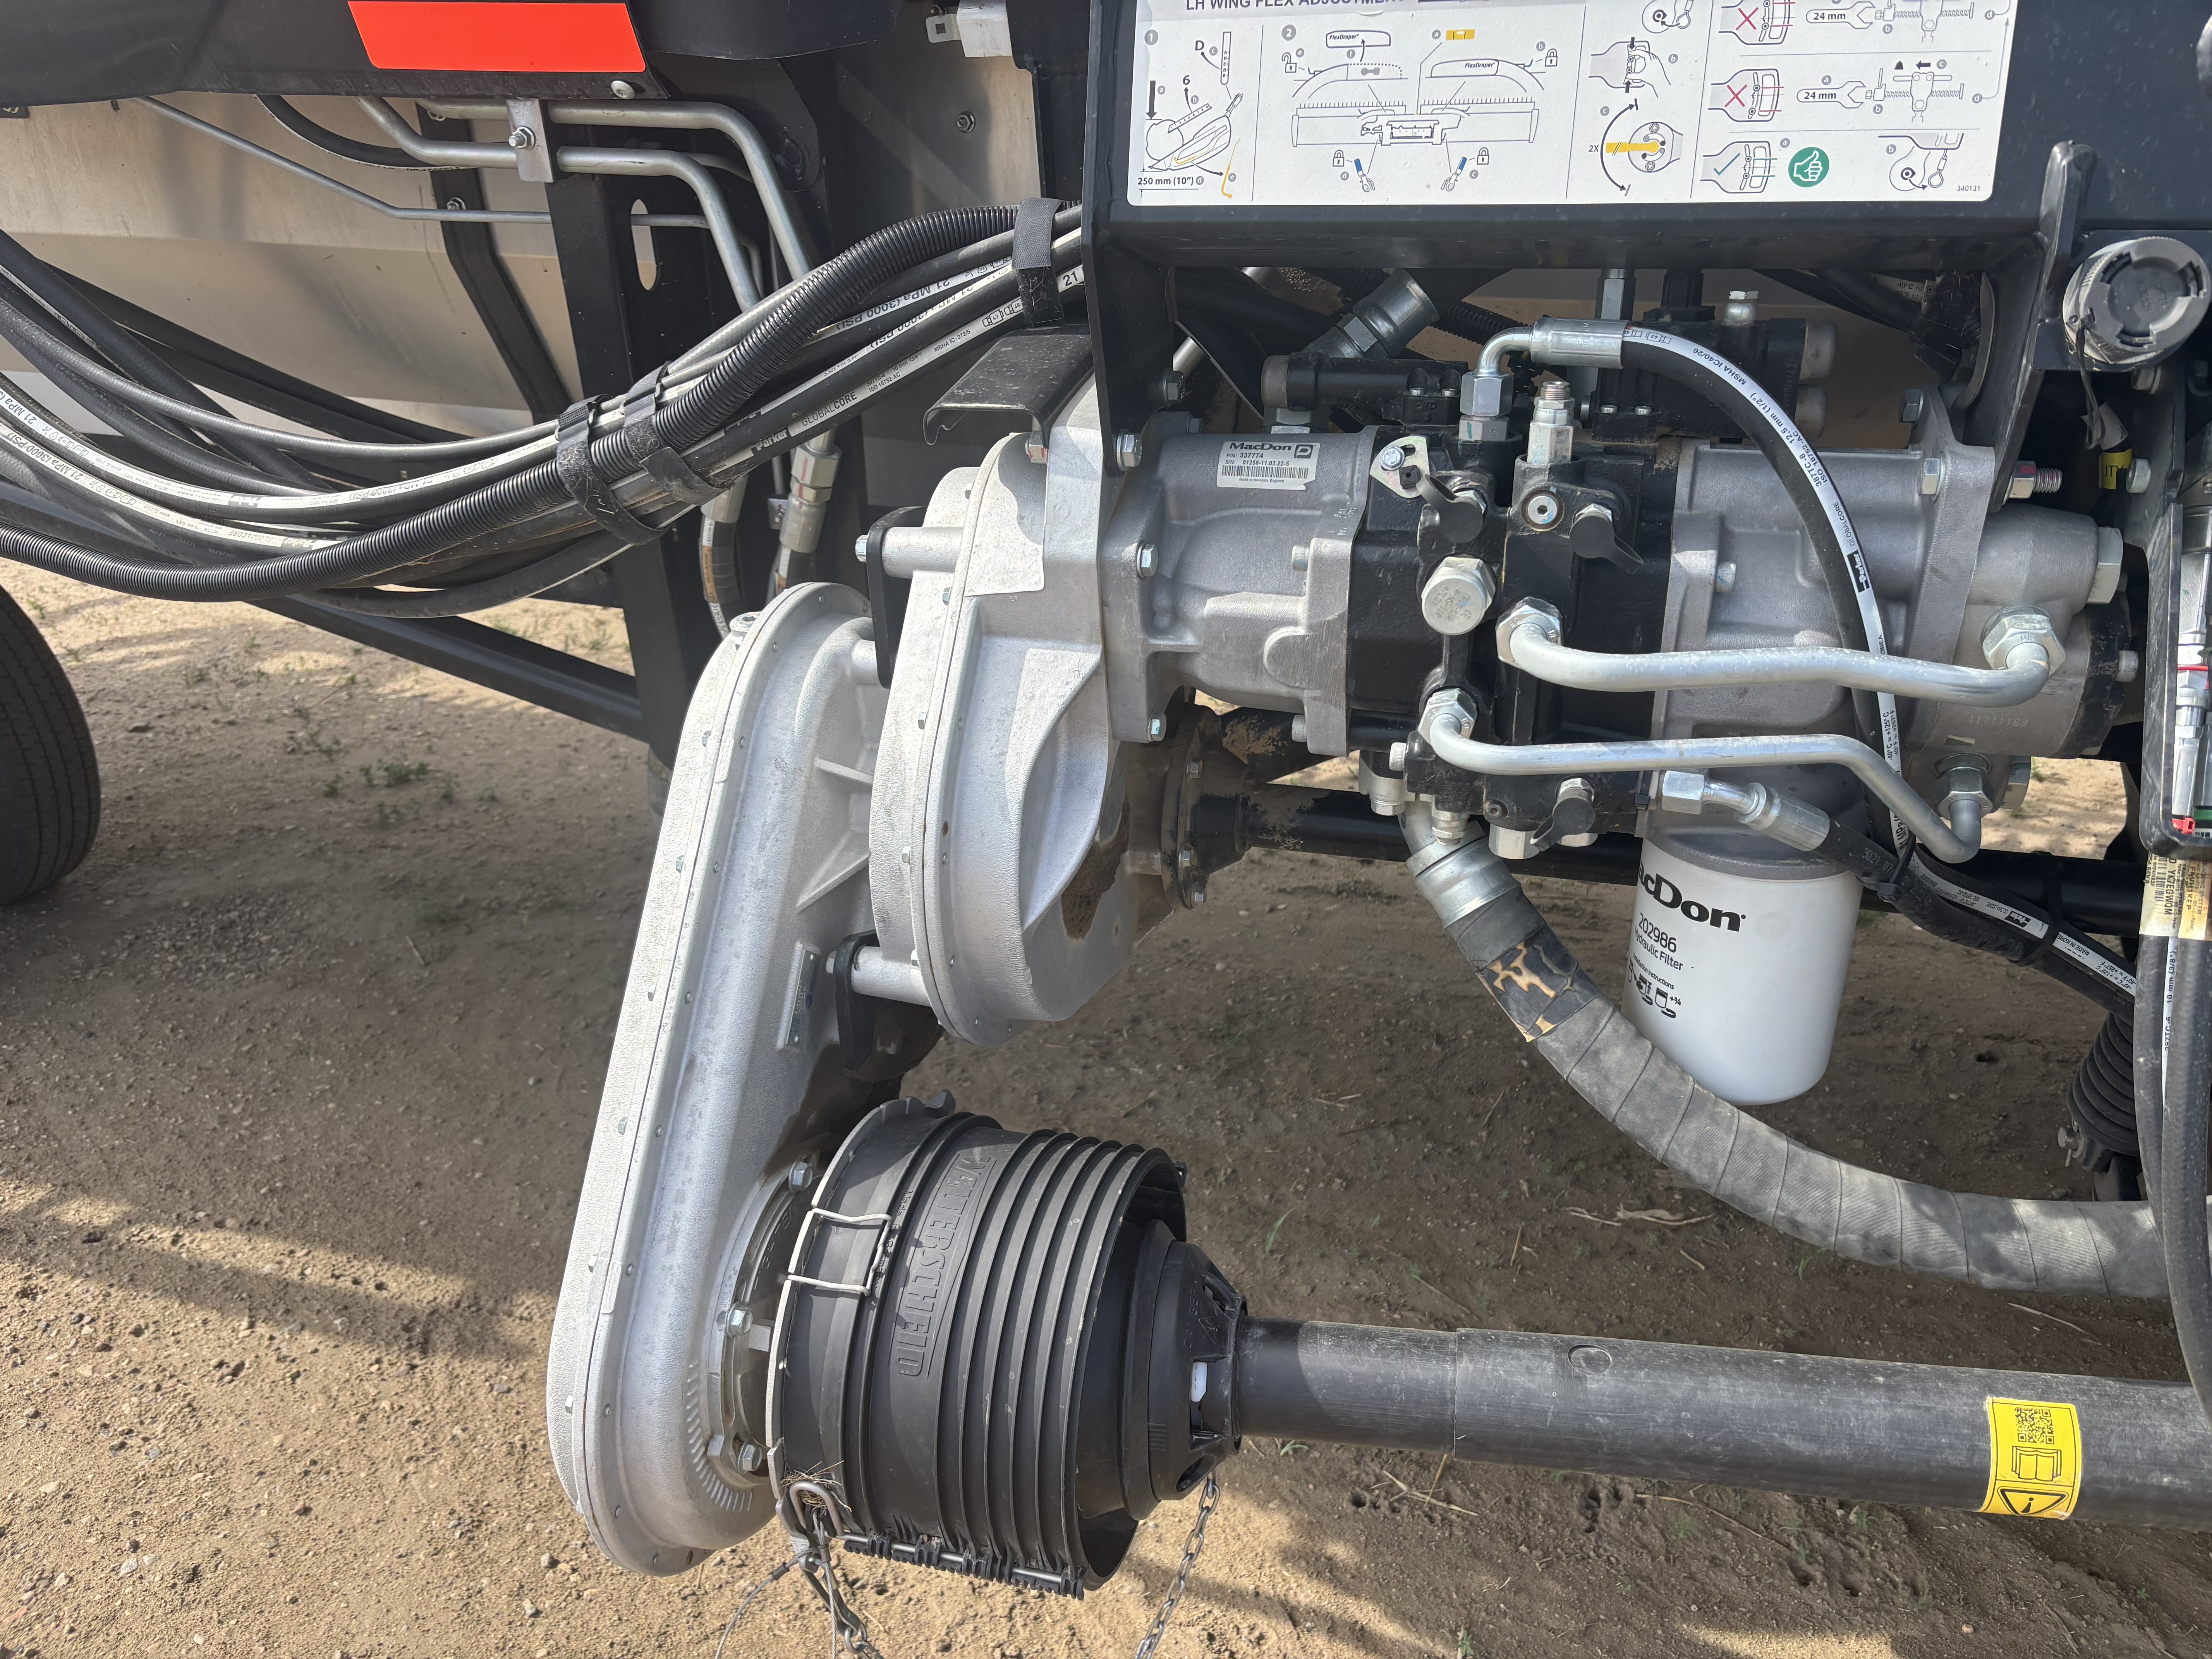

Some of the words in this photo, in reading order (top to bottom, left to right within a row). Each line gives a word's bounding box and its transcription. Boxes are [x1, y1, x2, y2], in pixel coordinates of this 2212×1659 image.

[1187, 0, 1204, 10] LH
[1211, 0, 1250, 9] WING
[1813, 12, 1826, 20] 24
[1195, 40, 1204, 51] D
[1182, 75, 1190, 85] 6
[1804, 91, 1816, 100] 24
[936, 278, 950, 289] 21
[1063, 271, 1079, 287] 21
[904, 285, 931, 301] MPa
[867, 300, 901, 318] (3000
[934, 341, 950, 352] MSHA
[1692, 348, 1723, 368] IC40/26
[869, 384, 878, 393] ISO
[879, 371, 901, 387] 18752-AC
[1724, 365, 1747, 385] MSHA
[6, 398, 24, 416] MPa
[801, 391, 858, 426] GLOBALCORE
[1750, 392, 1771, 414] (1/2")
[24, 414, 37, 424] 21
[1770, 412, 1784, 427] mm
[756, 429, 788, 452] Parker
[1781, 428, 1795, 444] 12,5
[26, 445, 52, 463] (3000
[1229, 442, 1292, 451] MacDon
[1792, 430, 1818, 466] 18752-AC
[52, 459, 72, 474] MPa
[1799, 453, 1822, 487] 387TC-8
[70, 471, 84, 481] 21
[1817, 468, 1828, 483] ISO
[1832, 501, 1855, 546] GLOBALCORE
[1853, 553, 1867, 583] Parker
[1638, 860, 1741, 932] acDon
[2009, 911, 2028, 924] Parker
[1638, 912, 1677, 953] 202986
[2057, 934, 2071, 945] KORE
[2075, 945, 2090, 957] MADE
[1659, 950, 1683, 971] Filter
[2167, 950, 2178, 975] (3/8")
[1648, 968, 1674, 990] Instructions
[2168, 977, 2174, 992] mm
[2166, 994, 2173, 1004] 10
